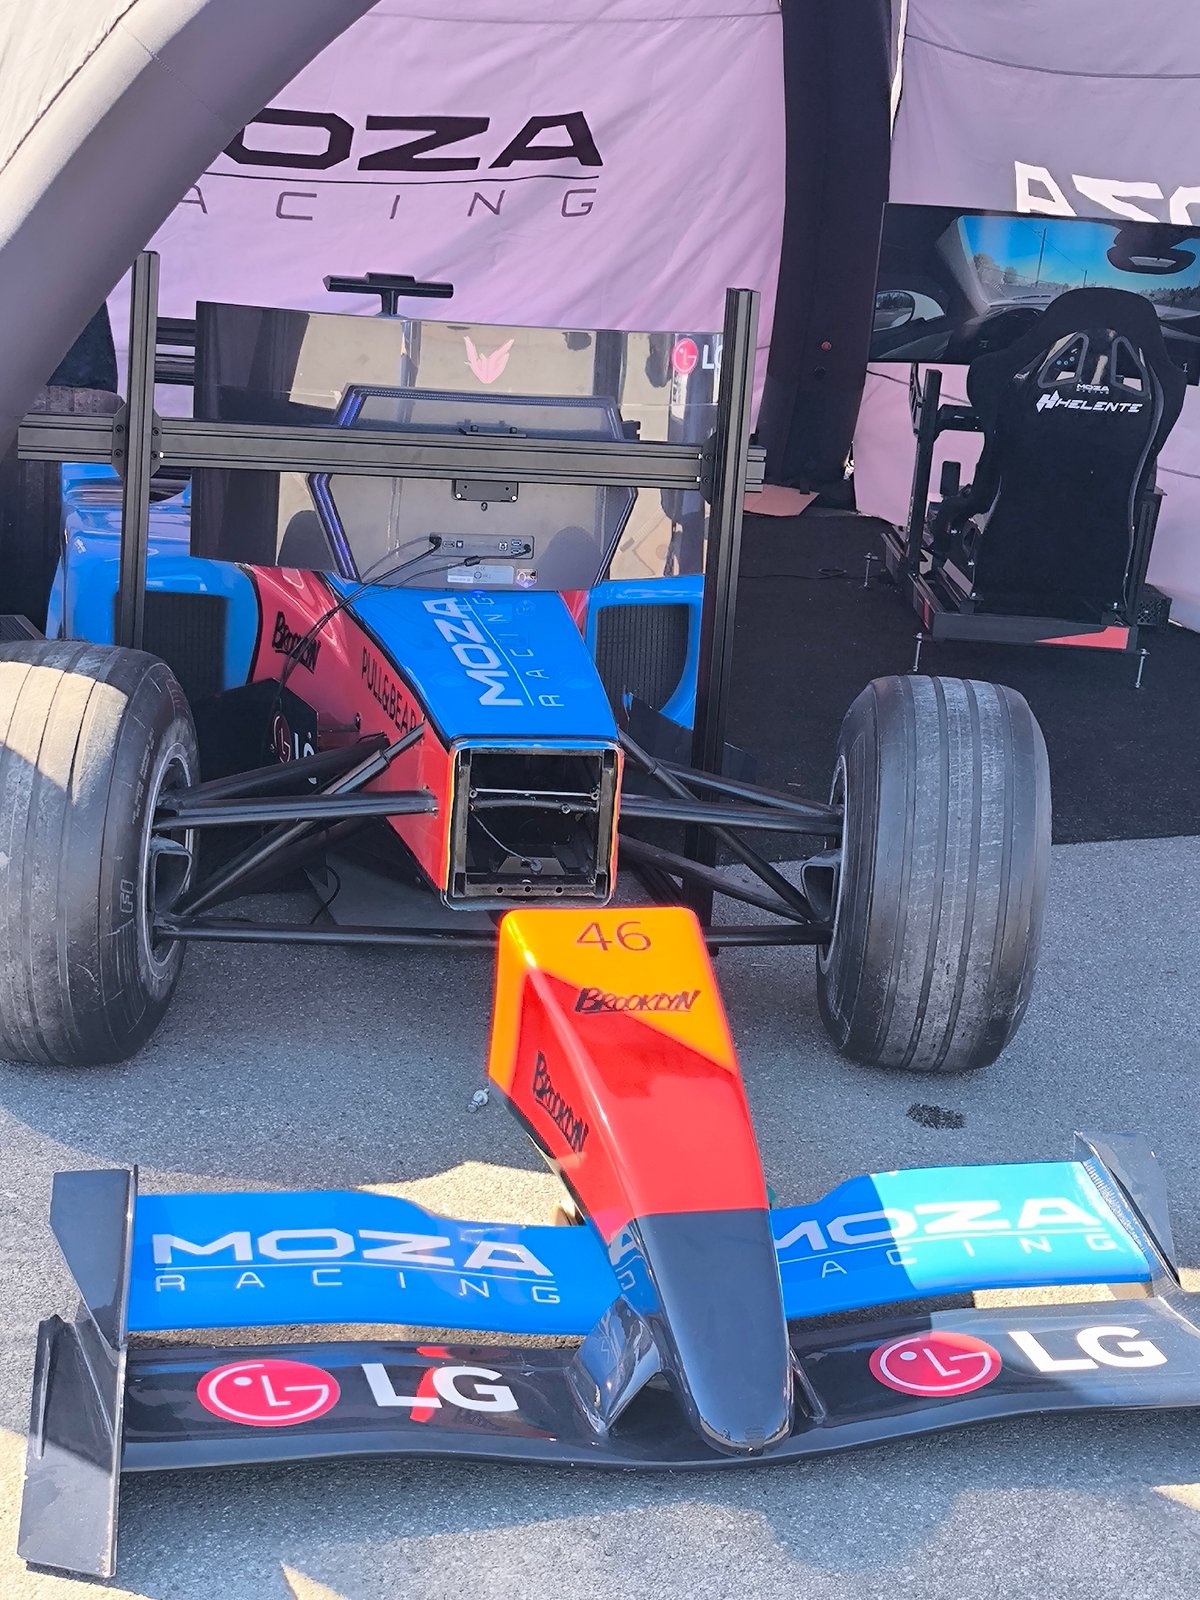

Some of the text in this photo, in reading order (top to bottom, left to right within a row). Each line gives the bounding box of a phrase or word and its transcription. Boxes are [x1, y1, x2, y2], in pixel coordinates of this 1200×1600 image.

[1076, 383, 1109, 392] MOZA
[422, 597, 524, 706] MOZA
[472, 597, 564, 706] RACING
[576, 921, 652, 951] 46
[575, 988, 701, 1013] BROOKLYN
[152, 1228, 553, 1276] MOZA
[155, 1268, 561, 1303] RACING
[1008, 1326, 1168, 1372] LG
[362, 1363, 519, 1412] LG
